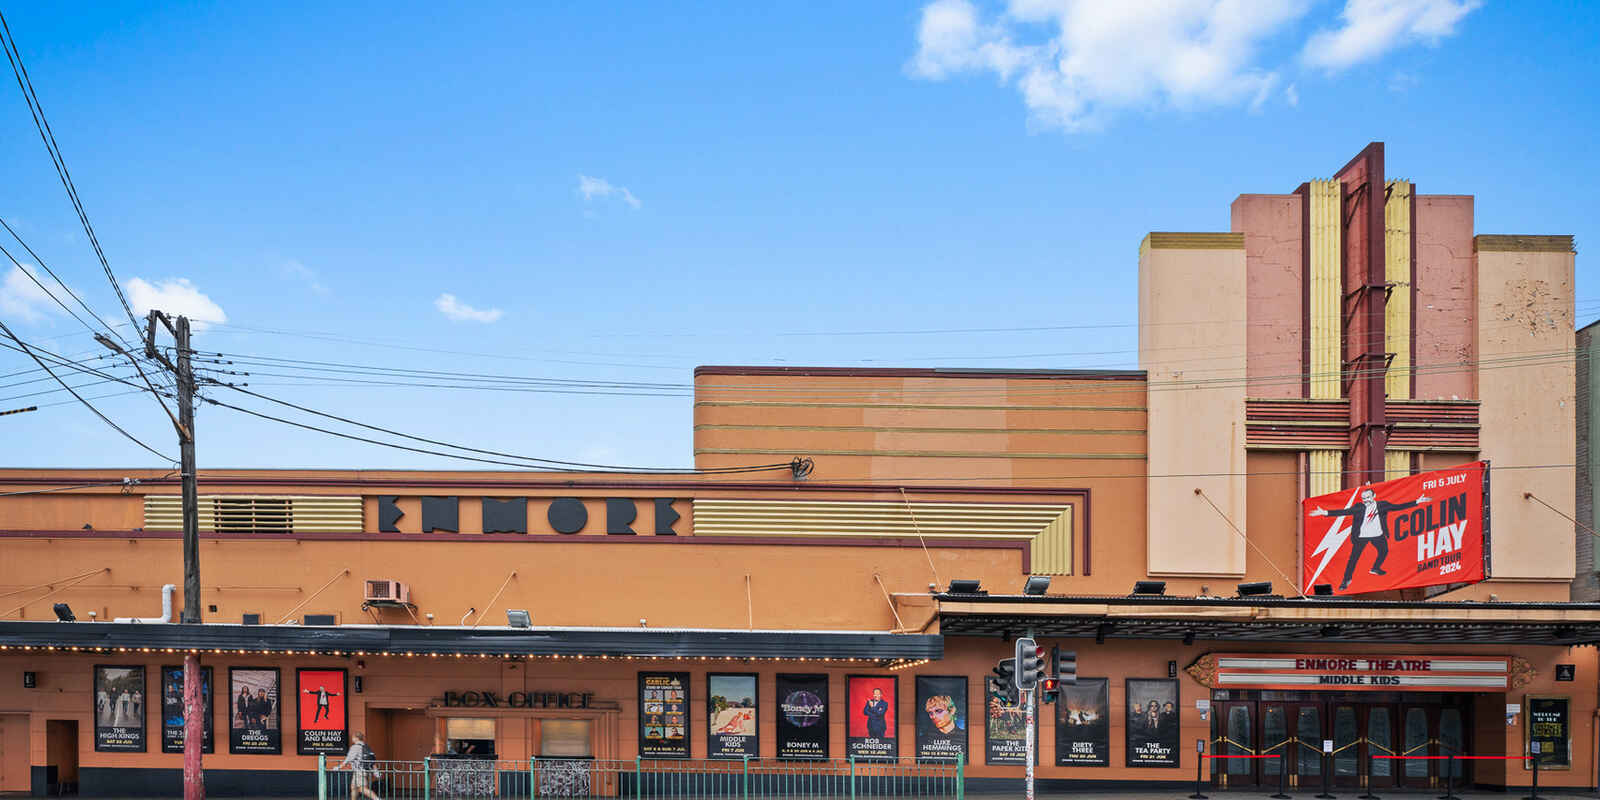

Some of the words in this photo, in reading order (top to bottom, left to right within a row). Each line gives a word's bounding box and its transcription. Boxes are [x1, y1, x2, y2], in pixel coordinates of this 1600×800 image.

[1423, 480, 1438, 490] FRI
[1445, 473, 1467, 486] JULY
[378, 496, 680, 535] ENMORE
[1394, 492, 1466, 541] COLIN
[1417, 520, 1468, 561] HAY
[1417, 557, 1438, 572] BAND
[1439, 551, 1461, 565] TOUR
[1440, 561, 1461, 576] 2024
[1295, 659, 1357, 670] ENMORE
[1366, 660, 1431, 671] THEATRE
[1319, 675, 1365, 685] MIDDLE
[1370, 676, 1400, 685] KIDS
[444, 691, 499, 708] BOX
[508, 691, 595, 708] OFFICE
